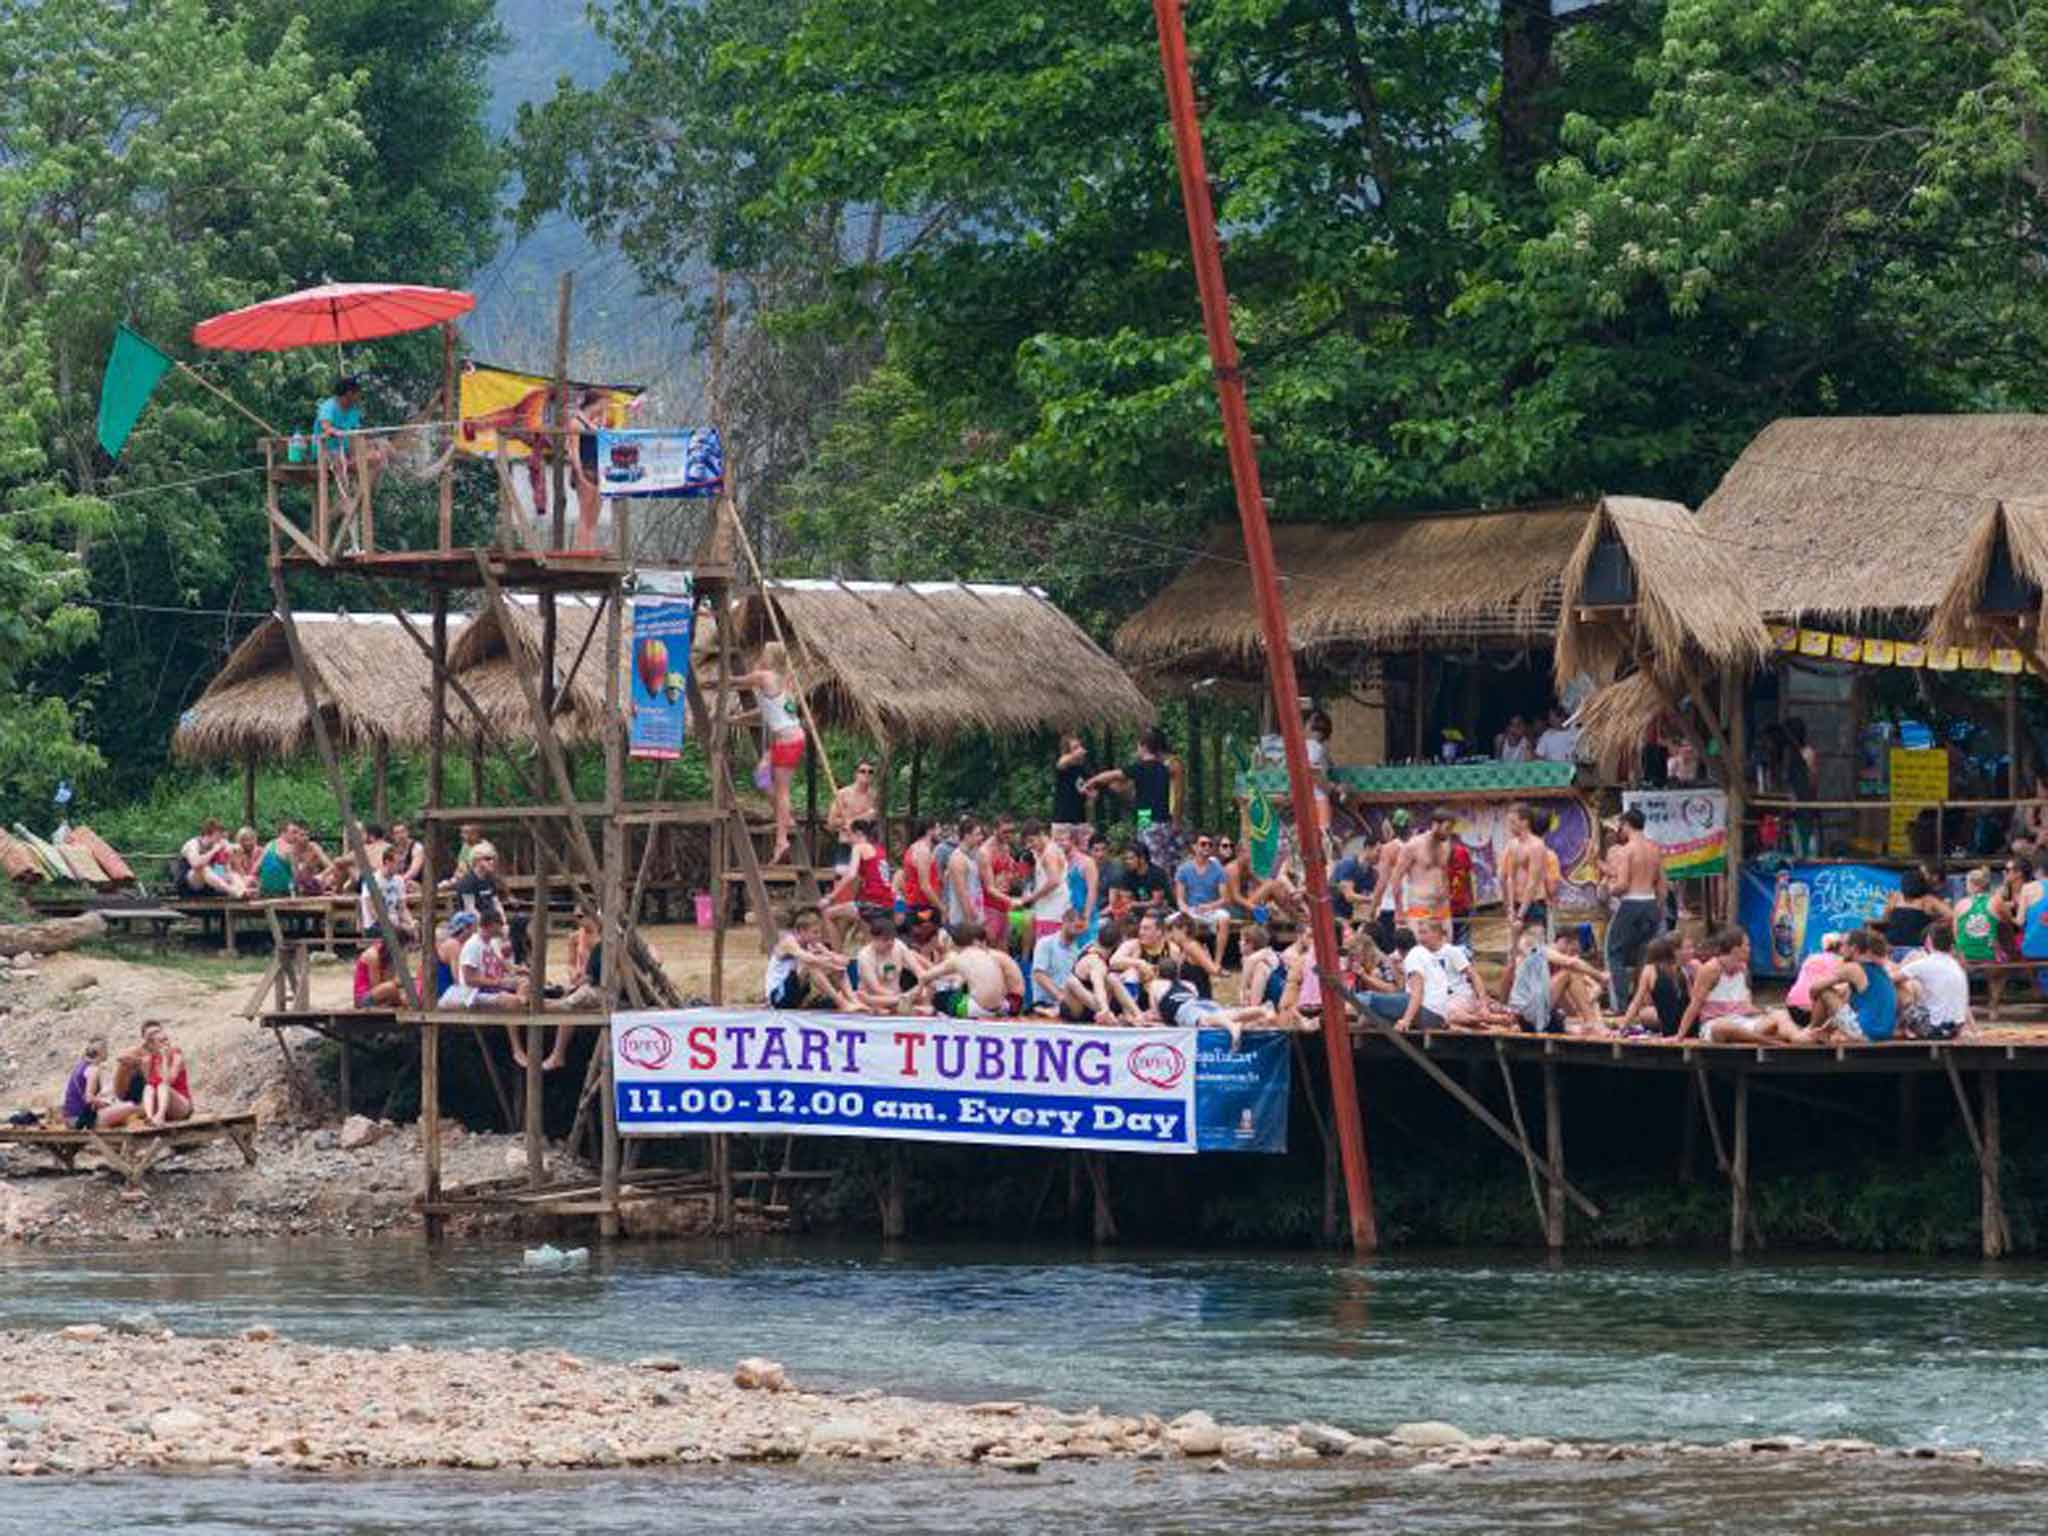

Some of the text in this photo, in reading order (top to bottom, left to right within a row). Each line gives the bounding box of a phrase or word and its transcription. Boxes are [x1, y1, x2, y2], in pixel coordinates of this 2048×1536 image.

[687, 1027, 1111, 1086] START TUBING
[627, 1088, 1179, 1138] 11.00-12.00 am. Every Day
